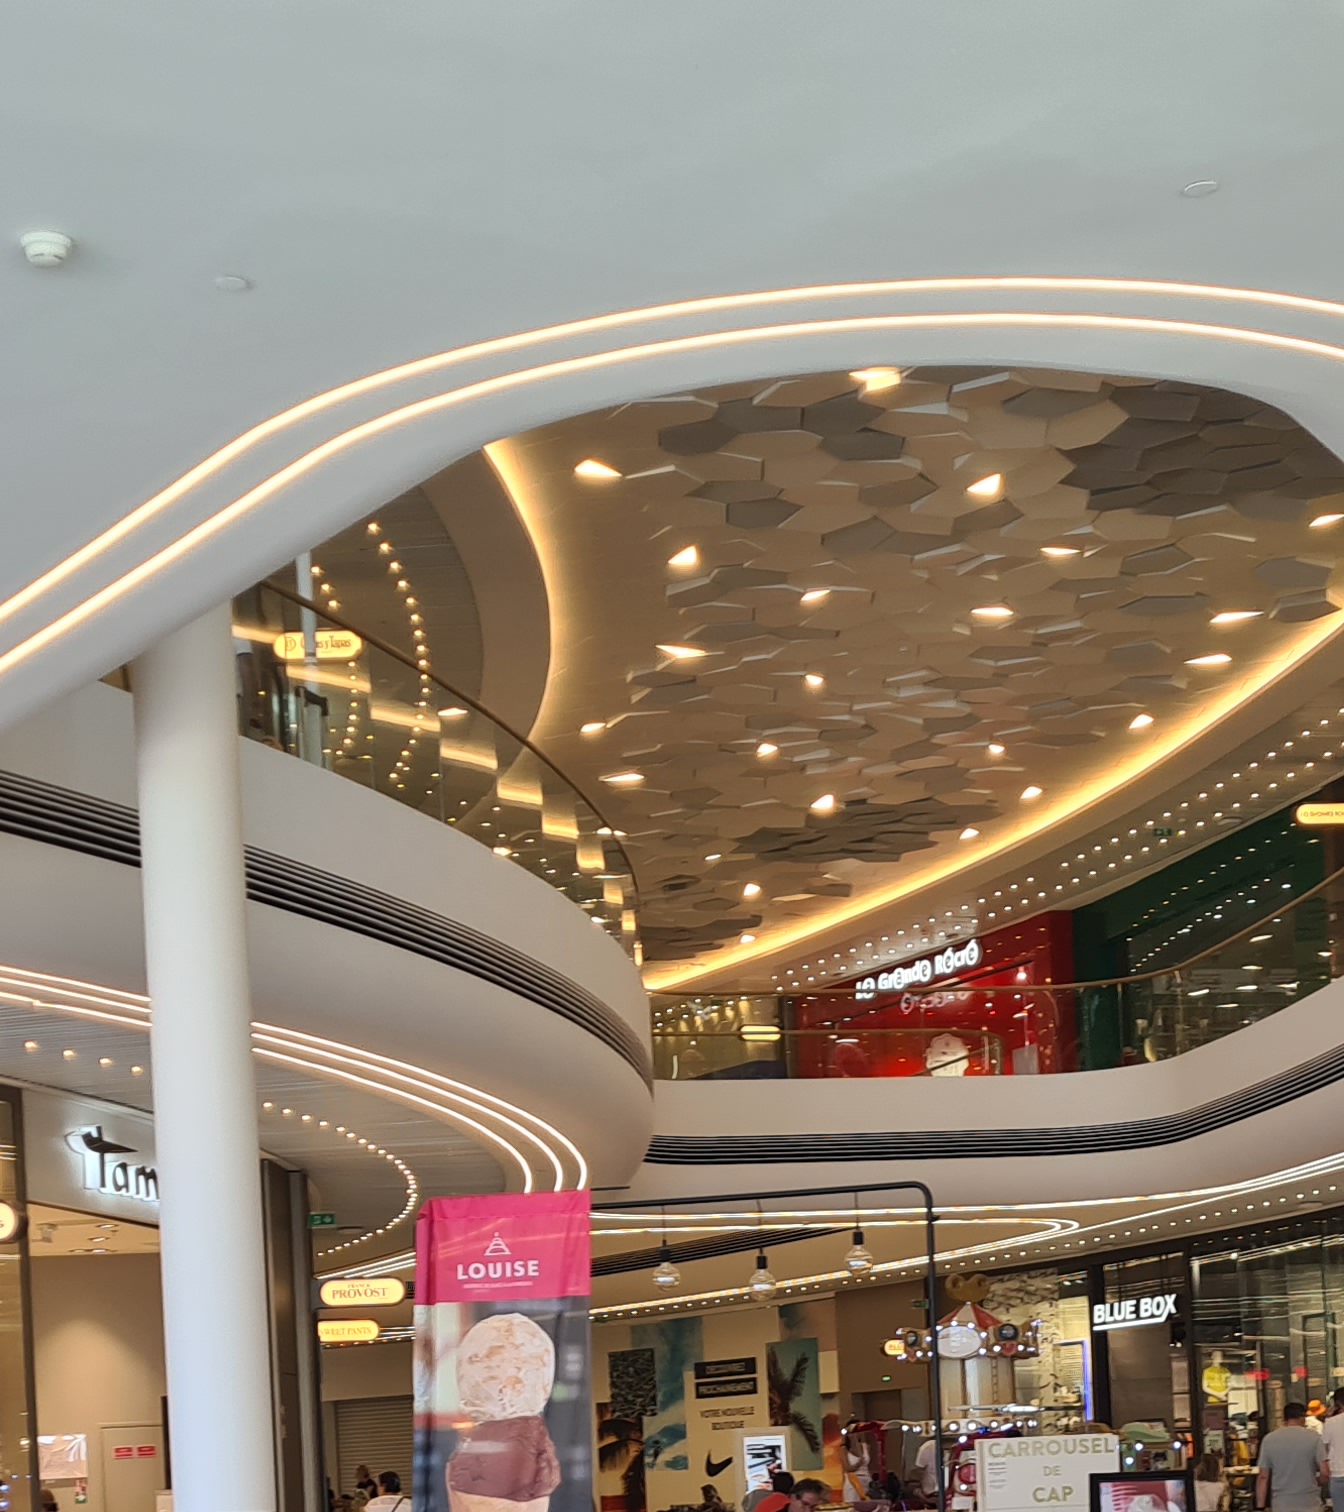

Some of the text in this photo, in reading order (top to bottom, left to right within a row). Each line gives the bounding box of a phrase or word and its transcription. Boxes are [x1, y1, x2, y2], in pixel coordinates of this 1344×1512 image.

[457, 1260, 540, 1280] LOUISE
[332, 1288, 387, 1299] PROVOST
[1093, 1293, 1177, 1324] BLUE BOX
[347, 1327, 371, 1335] PANTS
[988, 1437, 1115, 1458] CARROUSEL
[1042, 1465, 1062, 1476] DE
[1032, 1486, 1074, 1503] CAP
